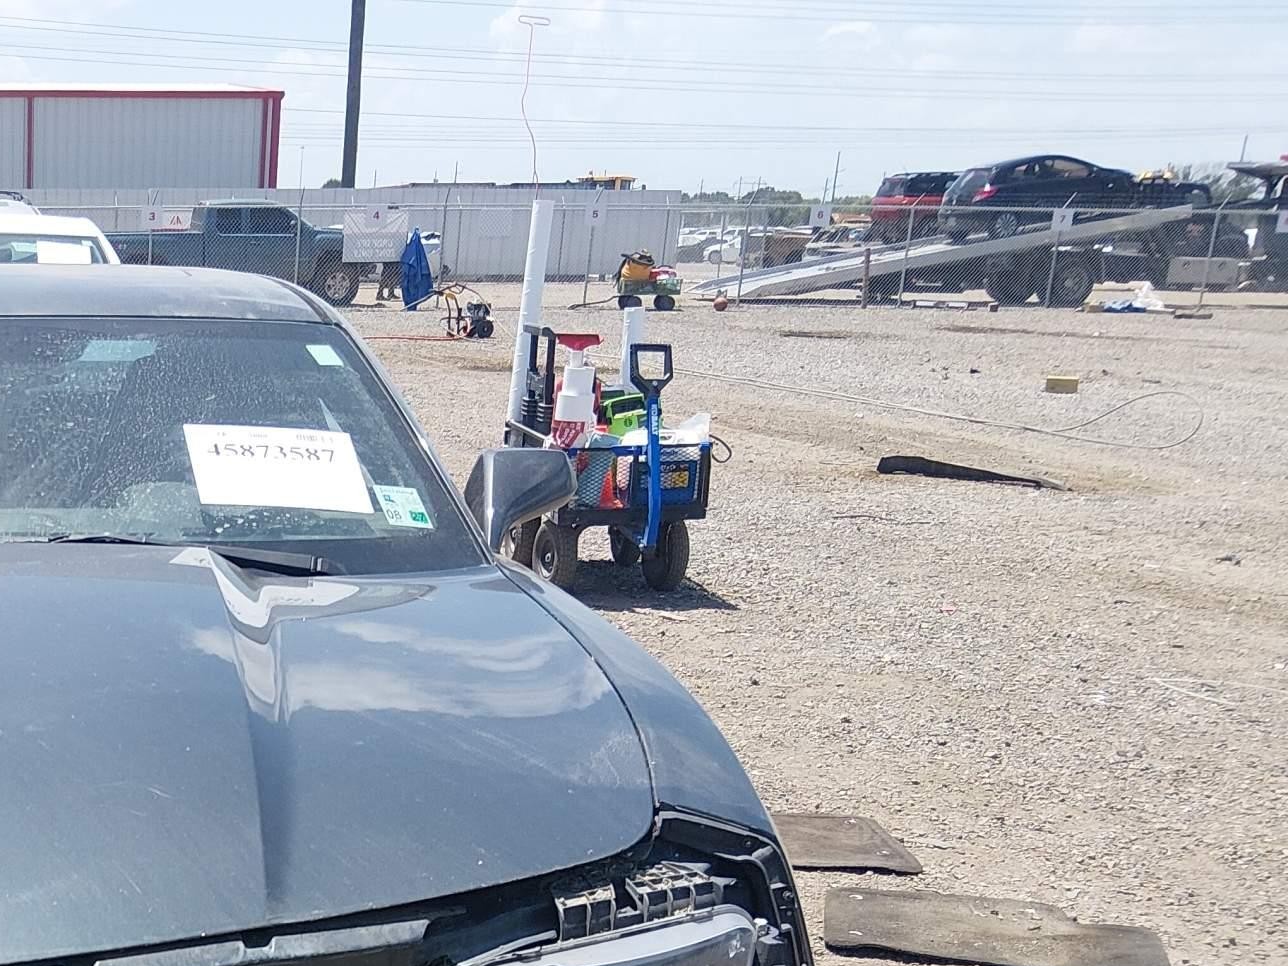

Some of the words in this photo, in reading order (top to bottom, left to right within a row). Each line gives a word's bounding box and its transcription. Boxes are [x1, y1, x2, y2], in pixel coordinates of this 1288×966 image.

[149, 212, 155, 221] 3
[373, 211, 380, 220] 4
[592, 210, 599, 218] 5
[651, 404, 659, 435] KOBALT
[208, 443, 335, 464] 45873587
